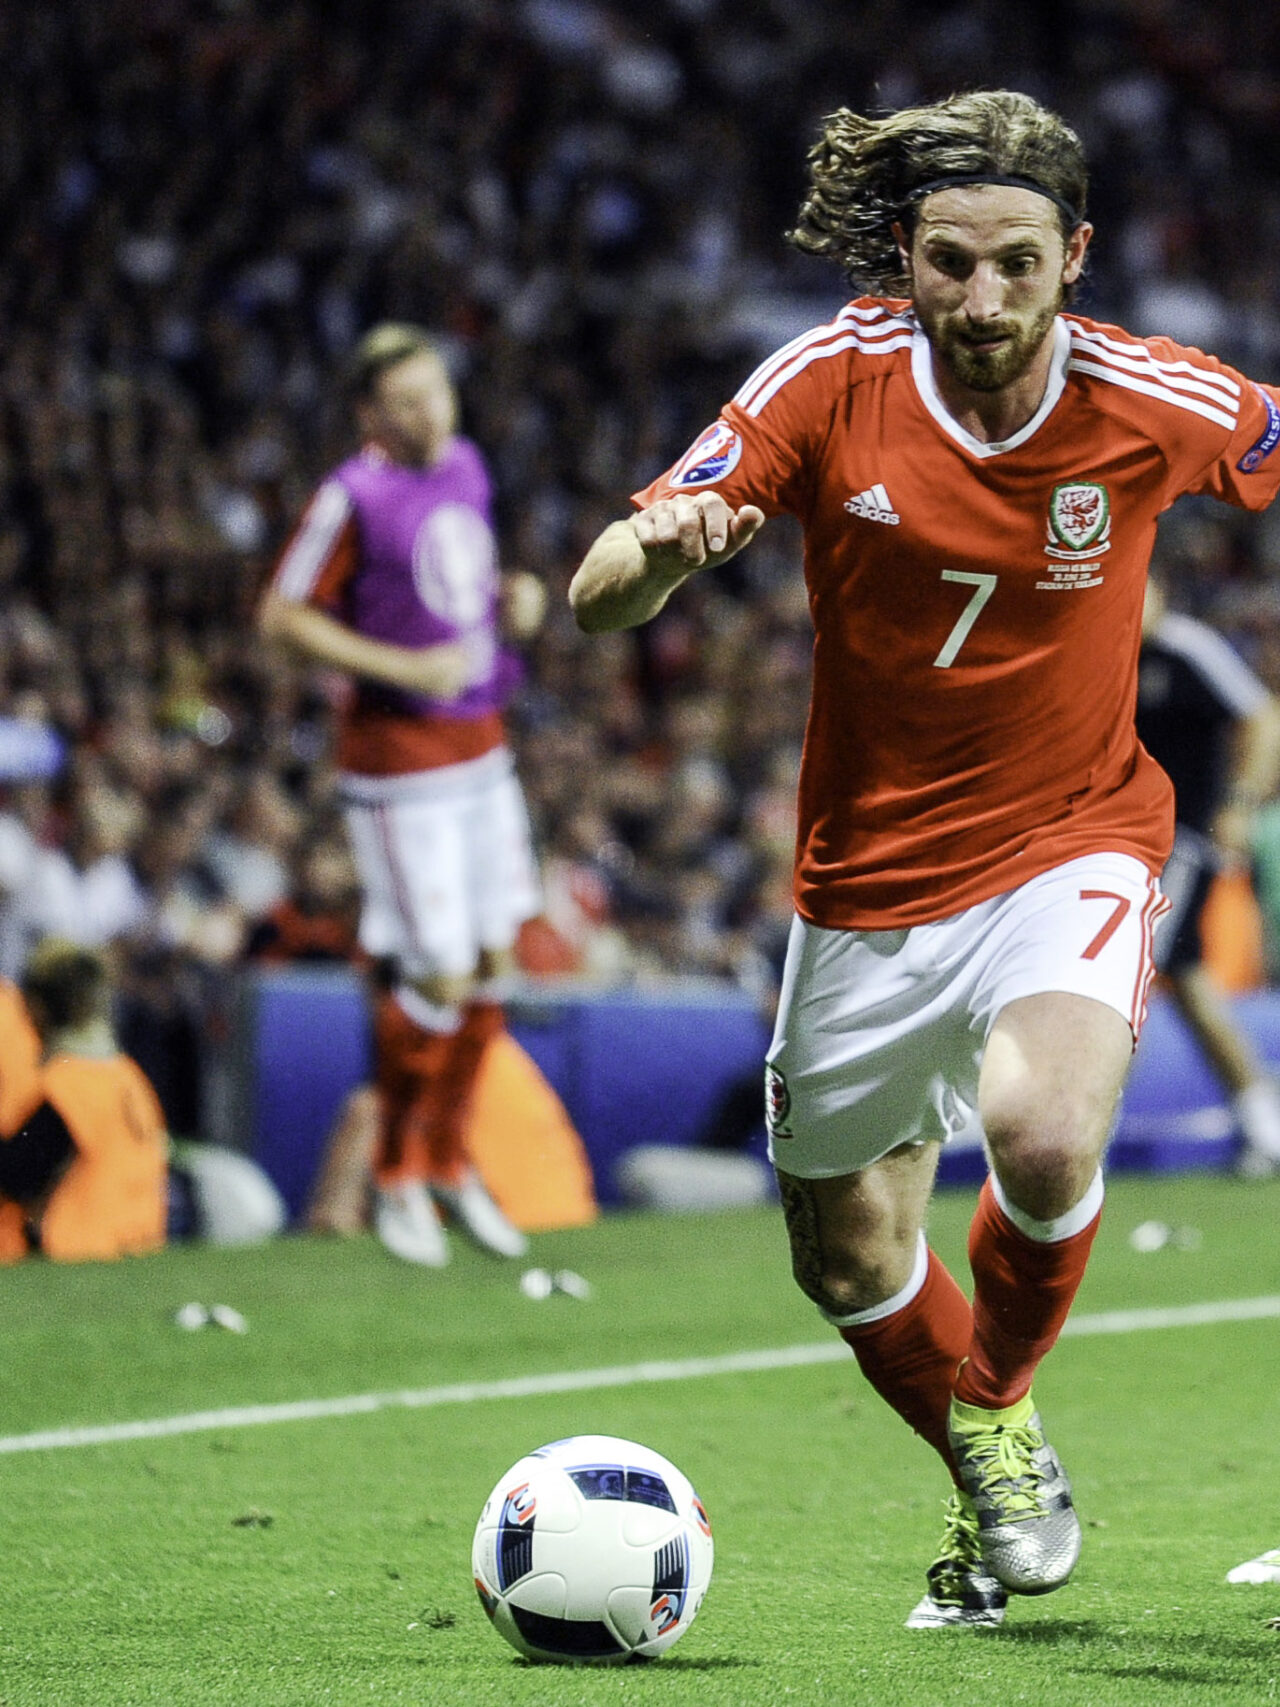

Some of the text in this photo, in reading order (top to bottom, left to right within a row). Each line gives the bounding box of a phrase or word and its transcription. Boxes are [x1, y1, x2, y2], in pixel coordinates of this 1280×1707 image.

[1260, 399, 1280, 450] RESP
[843, 501, 900, 525] adidas
[933, 569, 998, 668] 7
[1080, 890, 1131, 960] 7
